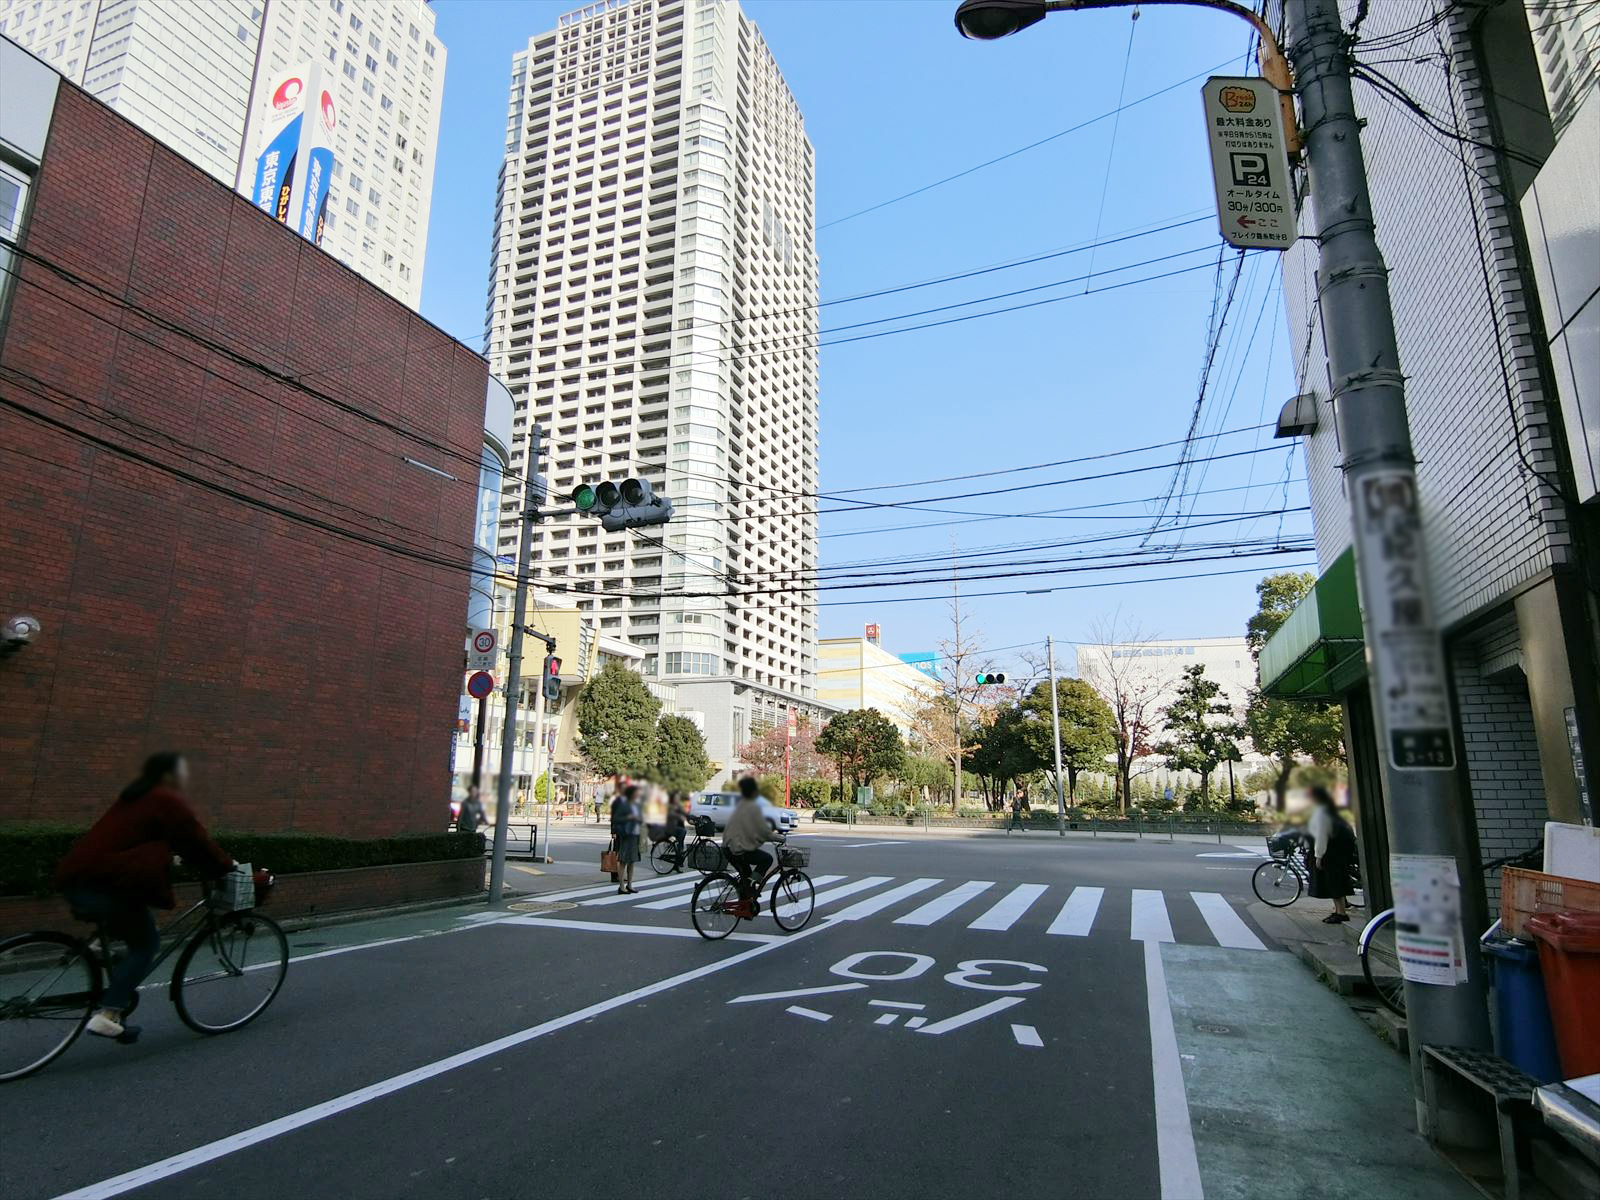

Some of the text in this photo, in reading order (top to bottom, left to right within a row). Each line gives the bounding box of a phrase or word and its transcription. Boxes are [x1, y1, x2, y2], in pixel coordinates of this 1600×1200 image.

[1216, 117, 1271, 128] 最大料金あり
[1233, 155, 1268, 185] P 24
[1227, 189, 1280, 199] オールタイム
[1227, 201, 1283, 213] 30分/300円
[1258, 218, 1280, 227] ここ
[479, 637, 491, 647] 30
[1406, 751, 1445, 763] 3-13
[829, 950, 1049, 992] 30
